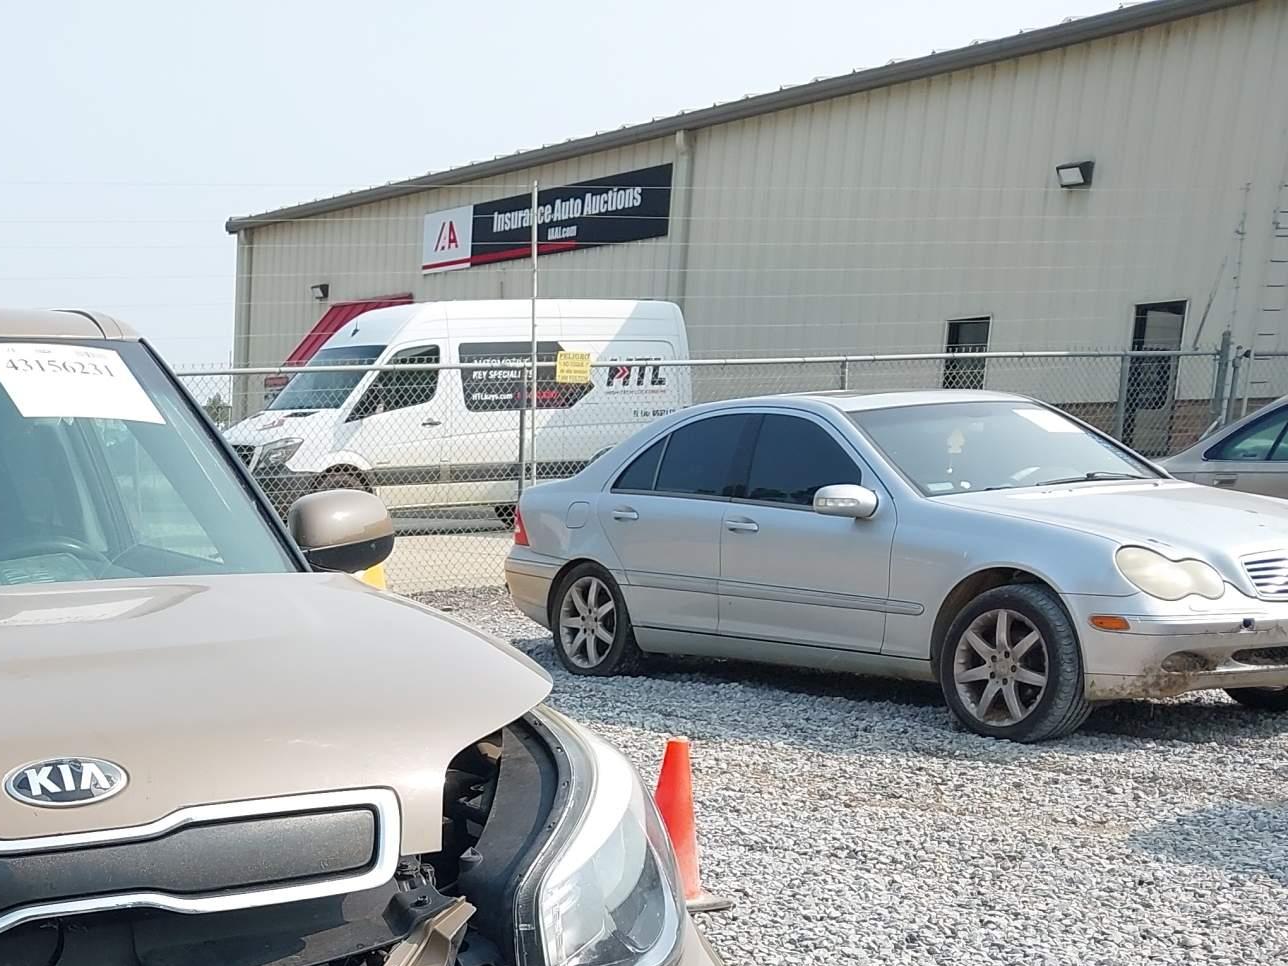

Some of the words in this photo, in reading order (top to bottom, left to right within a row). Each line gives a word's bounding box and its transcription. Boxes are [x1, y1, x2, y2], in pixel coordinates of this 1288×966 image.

[552, 198, 582, 222] Auto
[583, 186, 642, 217] Auctions
[6, 358, 114, 377] 43156231
[472, 370, 488, 380] KEY
[24, 762, 111, 796] KIA
